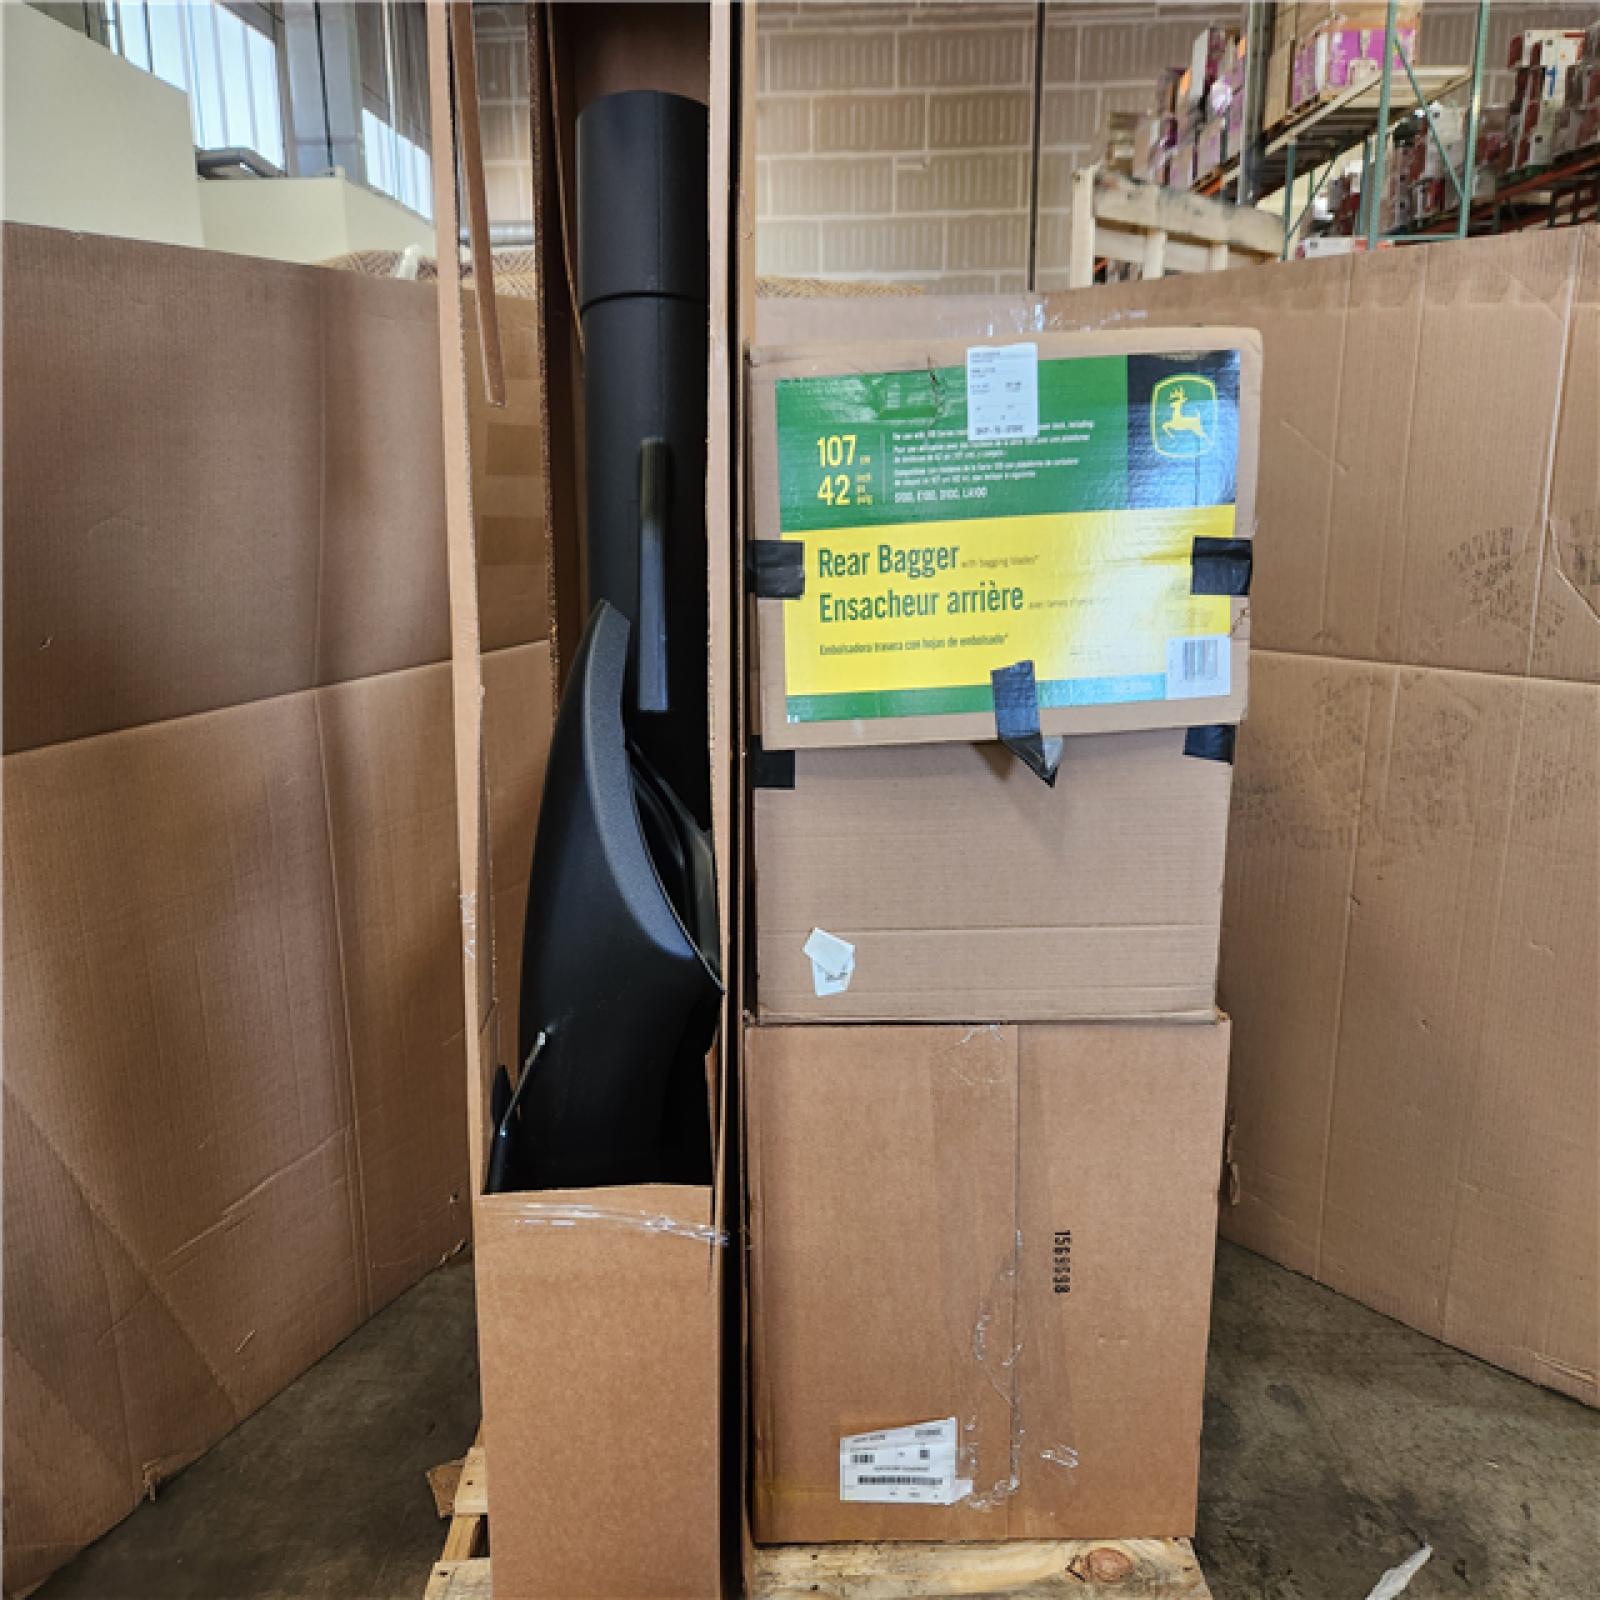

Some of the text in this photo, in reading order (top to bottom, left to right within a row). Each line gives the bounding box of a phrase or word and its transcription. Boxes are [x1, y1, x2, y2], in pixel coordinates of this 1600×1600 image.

[816, 434, 857, 469] 107
[816, 473, 851, 506] 42
[818, 547, 870, 578] Rear
[877, 543, 960, 579] Bagger
[819, 589, 939, 623] Ensacheur
[947, 580, 1023, 615] arrière
